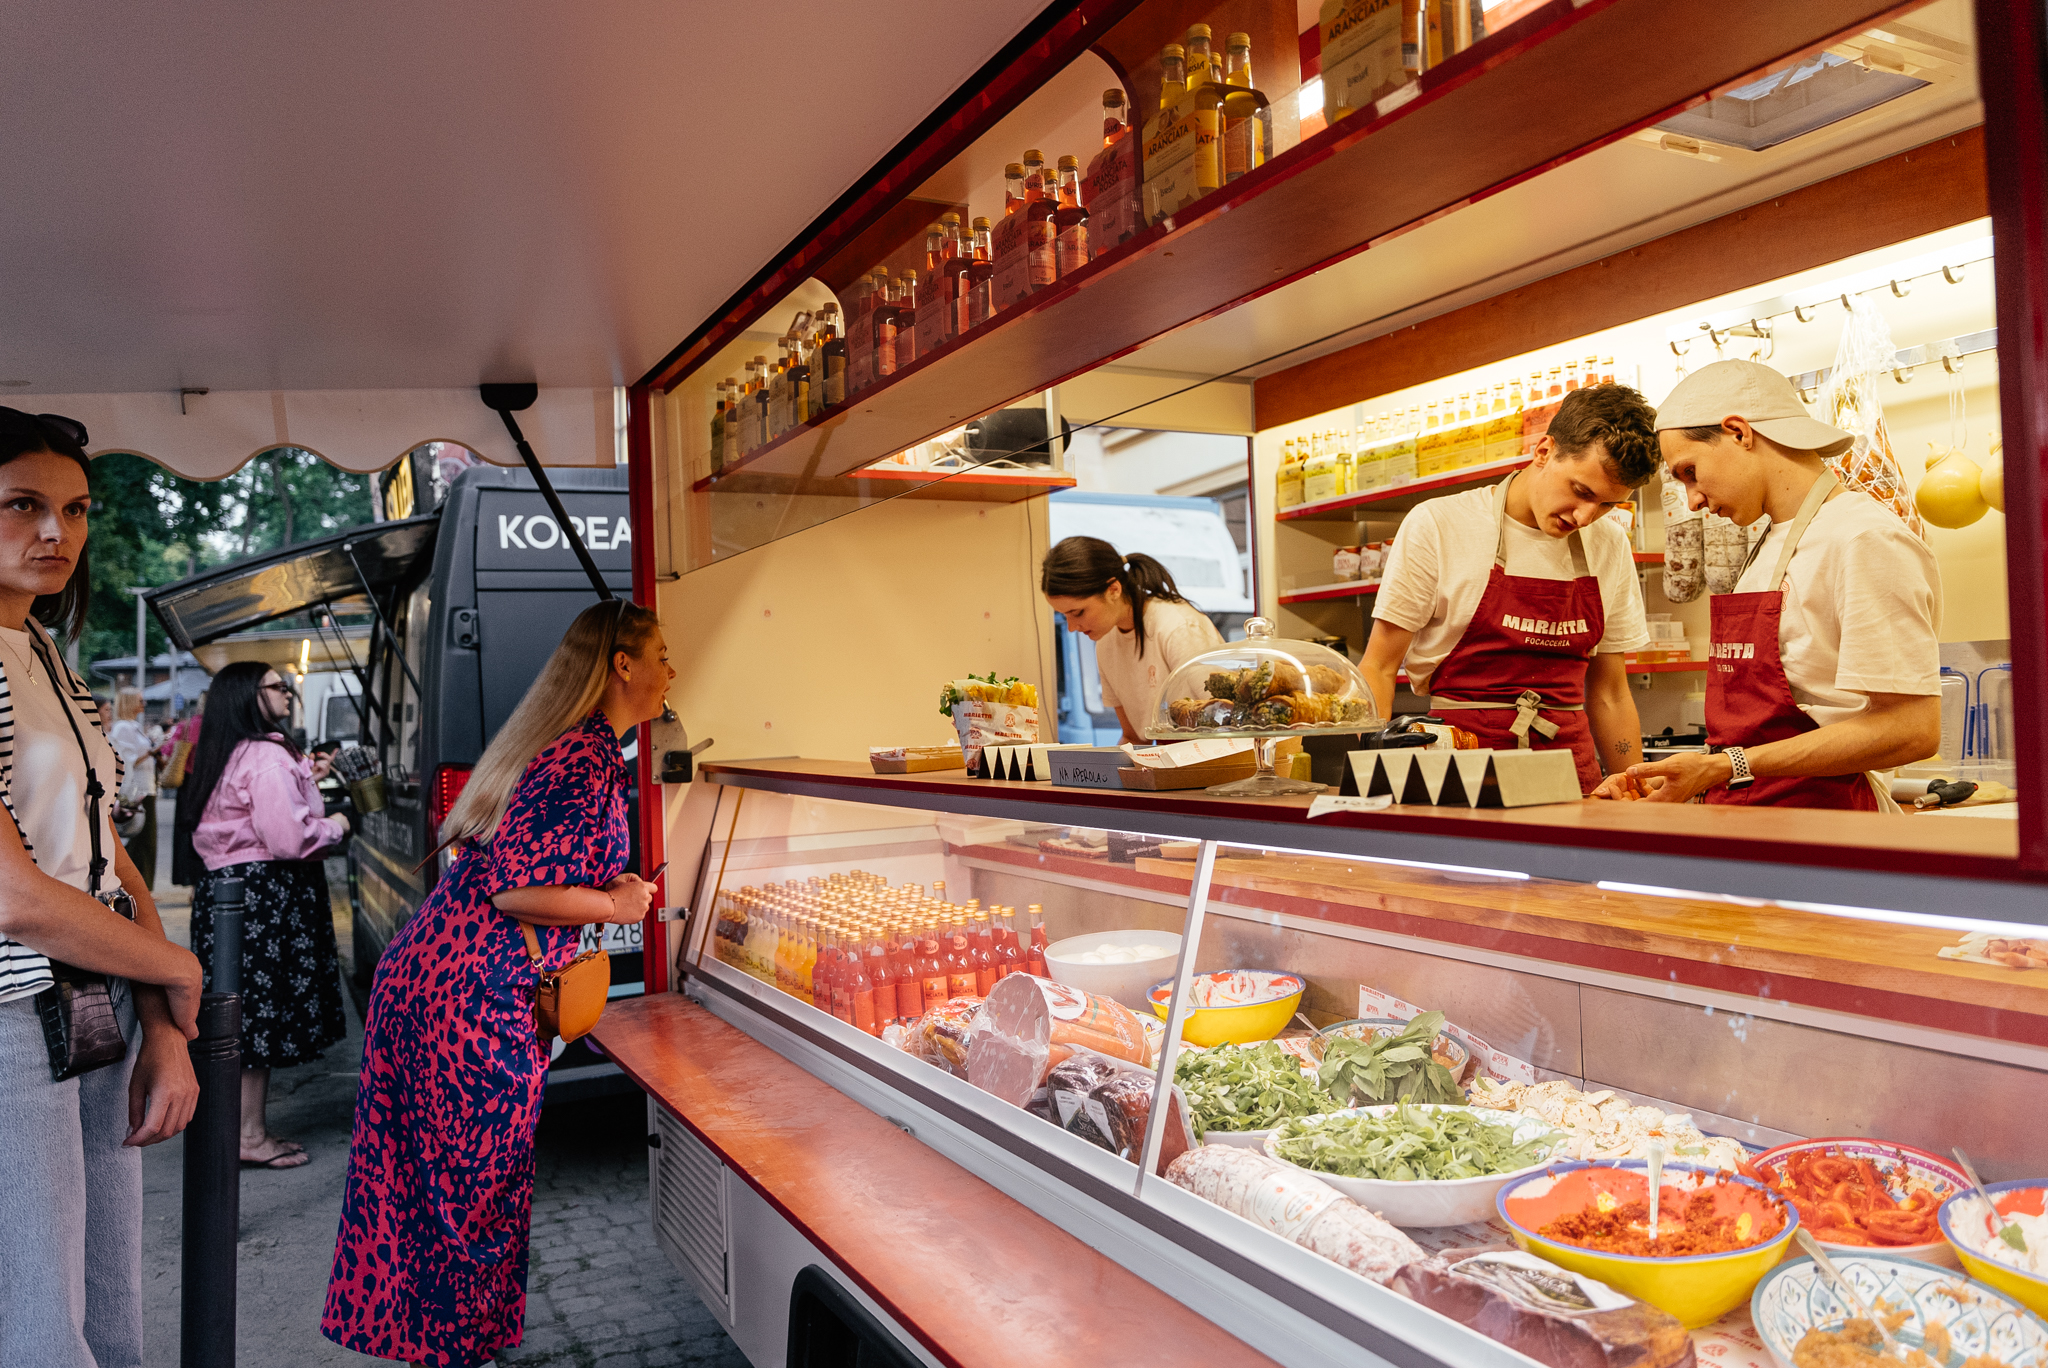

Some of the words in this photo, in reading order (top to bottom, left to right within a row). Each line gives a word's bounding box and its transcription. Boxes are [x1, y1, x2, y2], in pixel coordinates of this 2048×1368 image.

[1147, 125, 1189, 158] ARANCIATA
[1501, 613, 1590, 636] MARIETTA
[1524, 636, 1571, 647] FOCACCERIA
